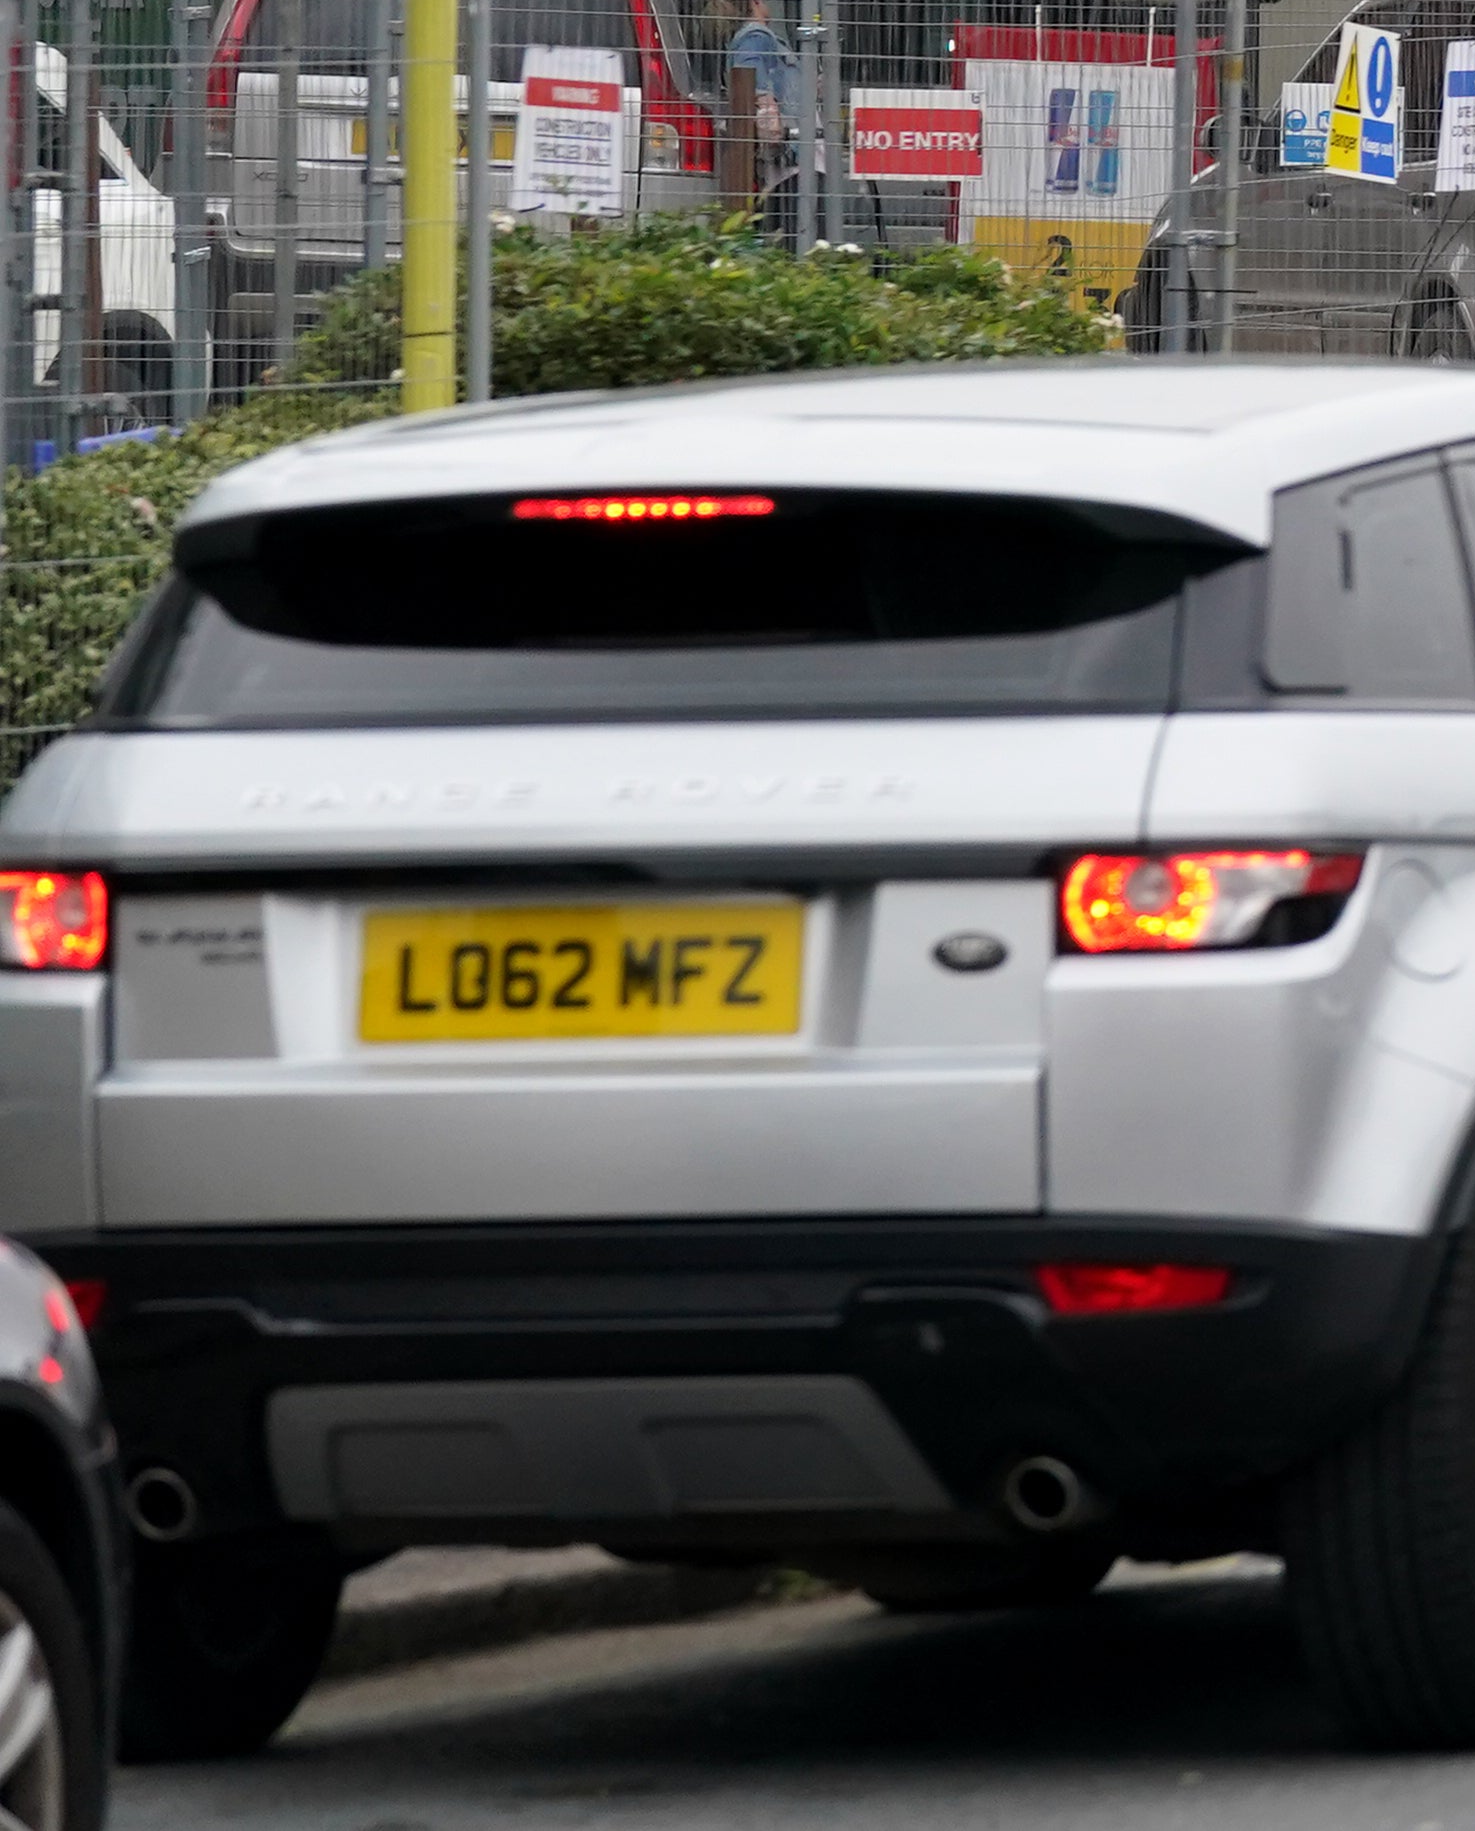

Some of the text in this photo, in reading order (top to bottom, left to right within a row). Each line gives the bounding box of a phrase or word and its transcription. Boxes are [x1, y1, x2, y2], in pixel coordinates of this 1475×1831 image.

[855, 130, 981, 152] NO ENTRY
[1330, 128, 1359, 155] Danger
[619, 934, 768, 1009] MFZ
